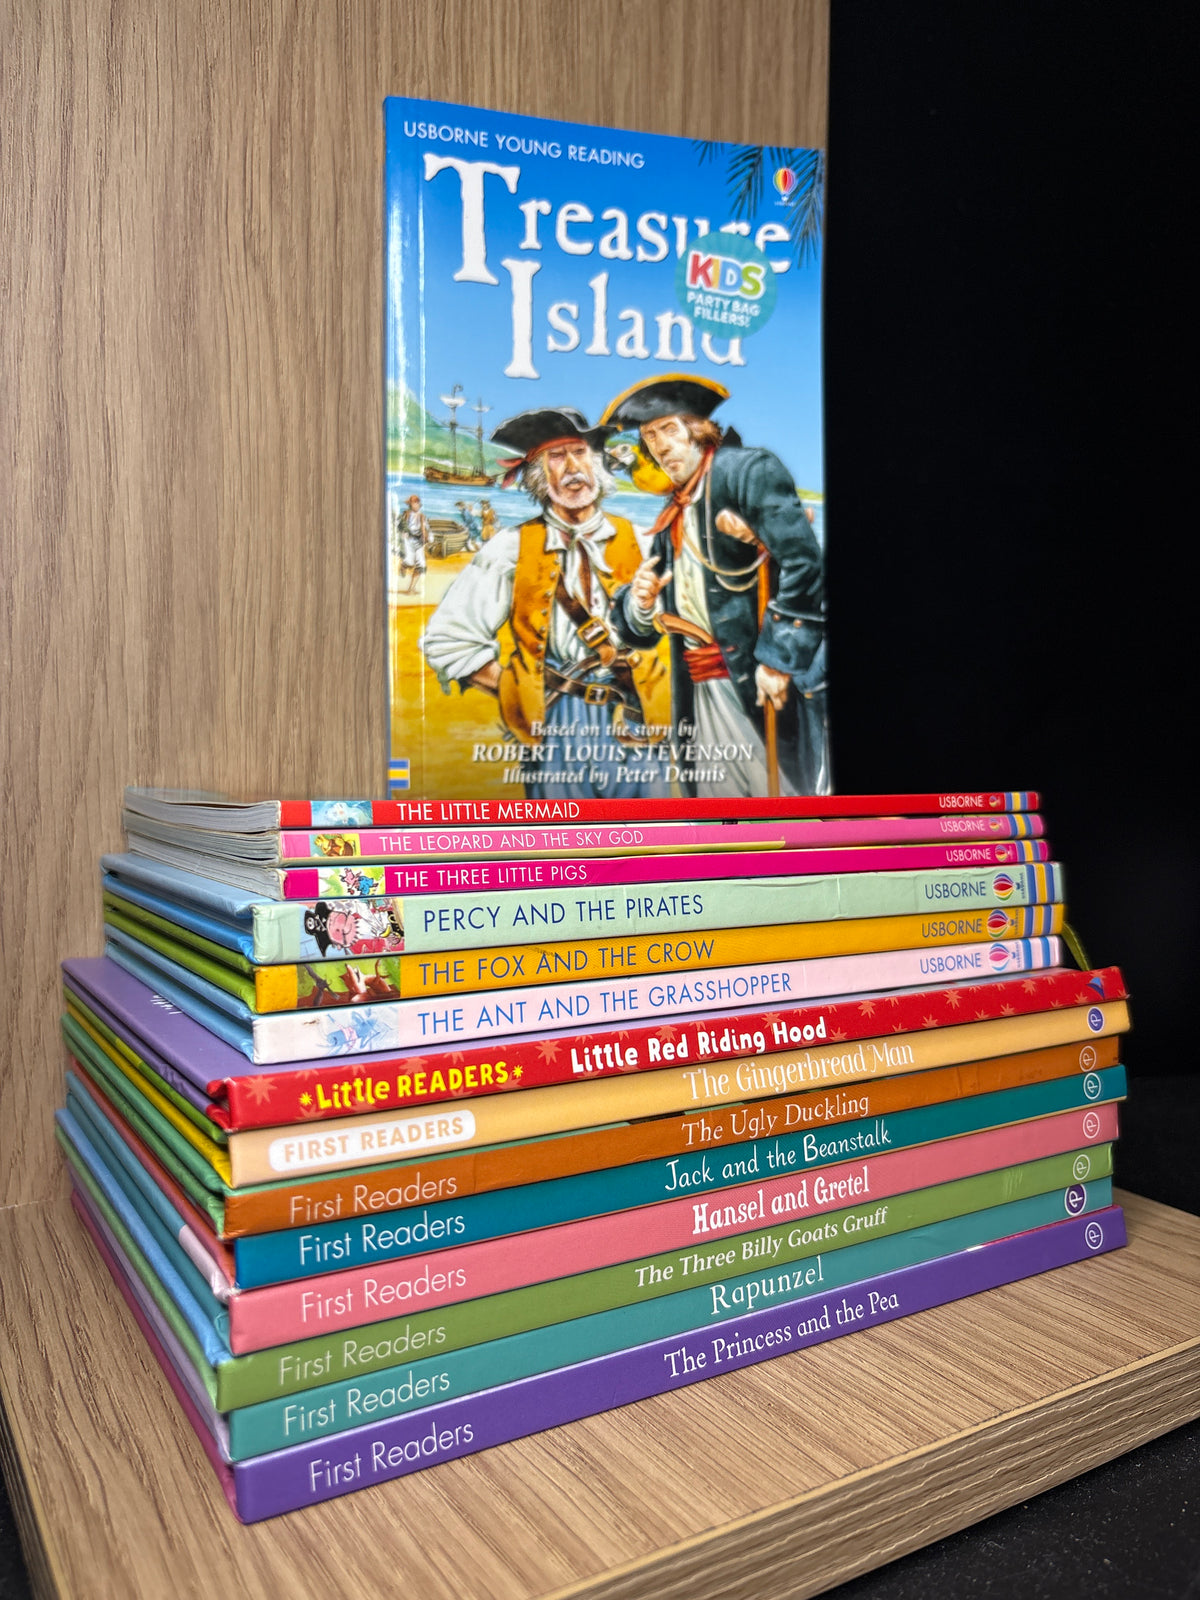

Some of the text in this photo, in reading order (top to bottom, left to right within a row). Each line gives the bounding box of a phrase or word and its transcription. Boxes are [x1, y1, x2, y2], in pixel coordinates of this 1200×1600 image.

[404, 121, 645, 169] USBORNE YOUNG READING
[423, 152, 792, 285] Treasue
[687, 251, 764, 299] KIDS
[687, 291, 761, 316] PARTY BAG
[472, 743, 753, 762] ROBERT LOUIS STEVENSON
[531, 717, 698, 741] Based on the story by
[503, 764, 726, 789] Illustrated by Peter Dennis
[397, 801, 580, 821] THE LITTLE MERMAID
[939, 795, 984, 808] USBORNE
[379, 830, 644, 852] THE LEOPARD AND THE SKY GOD
[940, 820, 986, 833] USBORNE
[394, 865, 587, 888] THE THREE LITTLE PIGS
[946, 848, 992, 862] USBORNE
[424, 894, 704, 932] PERCY AND THE PIRATES
[925, 881, 986, 899] USBORNE
[921, 919, 982, 938] USBORNE
[419, 939, 715, 985] THE FOX AND THE CROW
[920, 953, 981, 974] USBORNE
[418, 975, 792, 1035] THE ANT AND THE GRASSHOPPER
[570, 1016, 827, 1073] Little Red Riding Hood
[316, 1062, 509, 1109] Little READERS
[683, 1041, 915, 1100] The Gingerbread Man
[284, 1117, 464, 1162] FIRST READERS
[681, 1093, 870, 1146] The Ugly Duckling
[665, 1119, 892, 1190] Jack and the Beanstalk
[290, 1172, 457, 1224] First Readers
[692, 1166, 870, 1235] Hansel and Gretel
[300, 1211, 466, 1265] First Readers
[635, 1206, 889, 1288] The Three Billy Goats Gruff
[301, 1264, 467, 1322] First Readers
[709, 1255, 825, 1315] Rapunzel
[279, 1324, 447, 1385] First Readers
[664, 1291, 900, 1378] The Princess and the Pea
[283, 1370, 450, 1436] First Readers
[309, 1422, 474, 1492] First Readers
